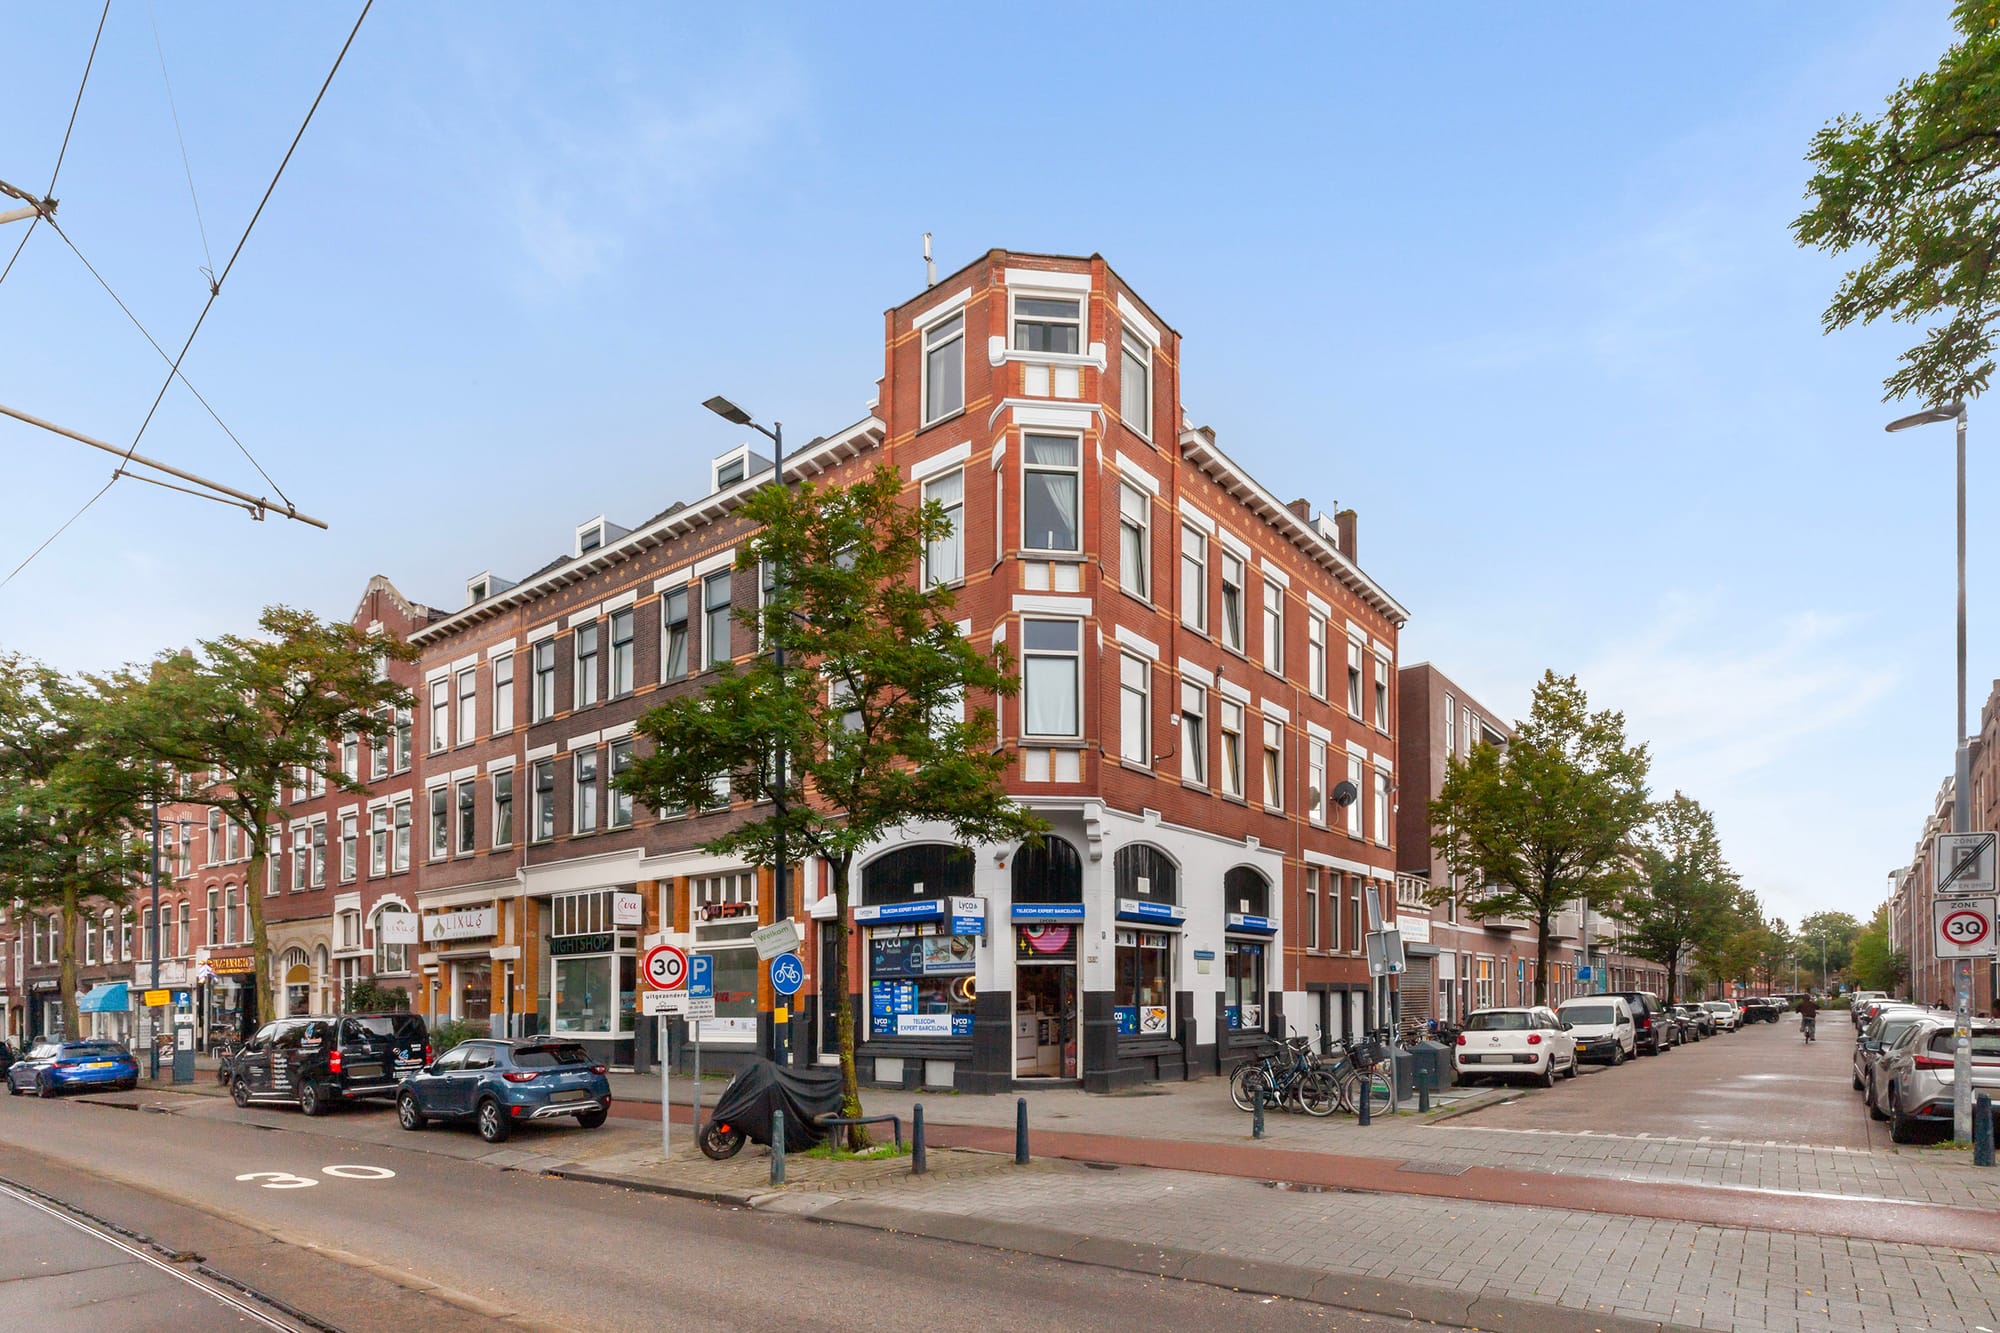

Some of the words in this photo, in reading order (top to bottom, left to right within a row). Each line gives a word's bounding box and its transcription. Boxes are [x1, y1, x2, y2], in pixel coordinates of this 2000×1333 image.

[1951, 901, 1978, 909] ZONE
[758, 926, 789, 941] Welkom
[551, 934, 610, 953] NIGHTSHOP
[653, 959, 680, 976] 30
[693, 959, 707, 980] P
[180, 992, 188, 1000] P
[874, 1017, 888, 1025] Lyca
[952, 1017, 968, 1026] Lyca
[235, 1165, 396, 1189] 30
